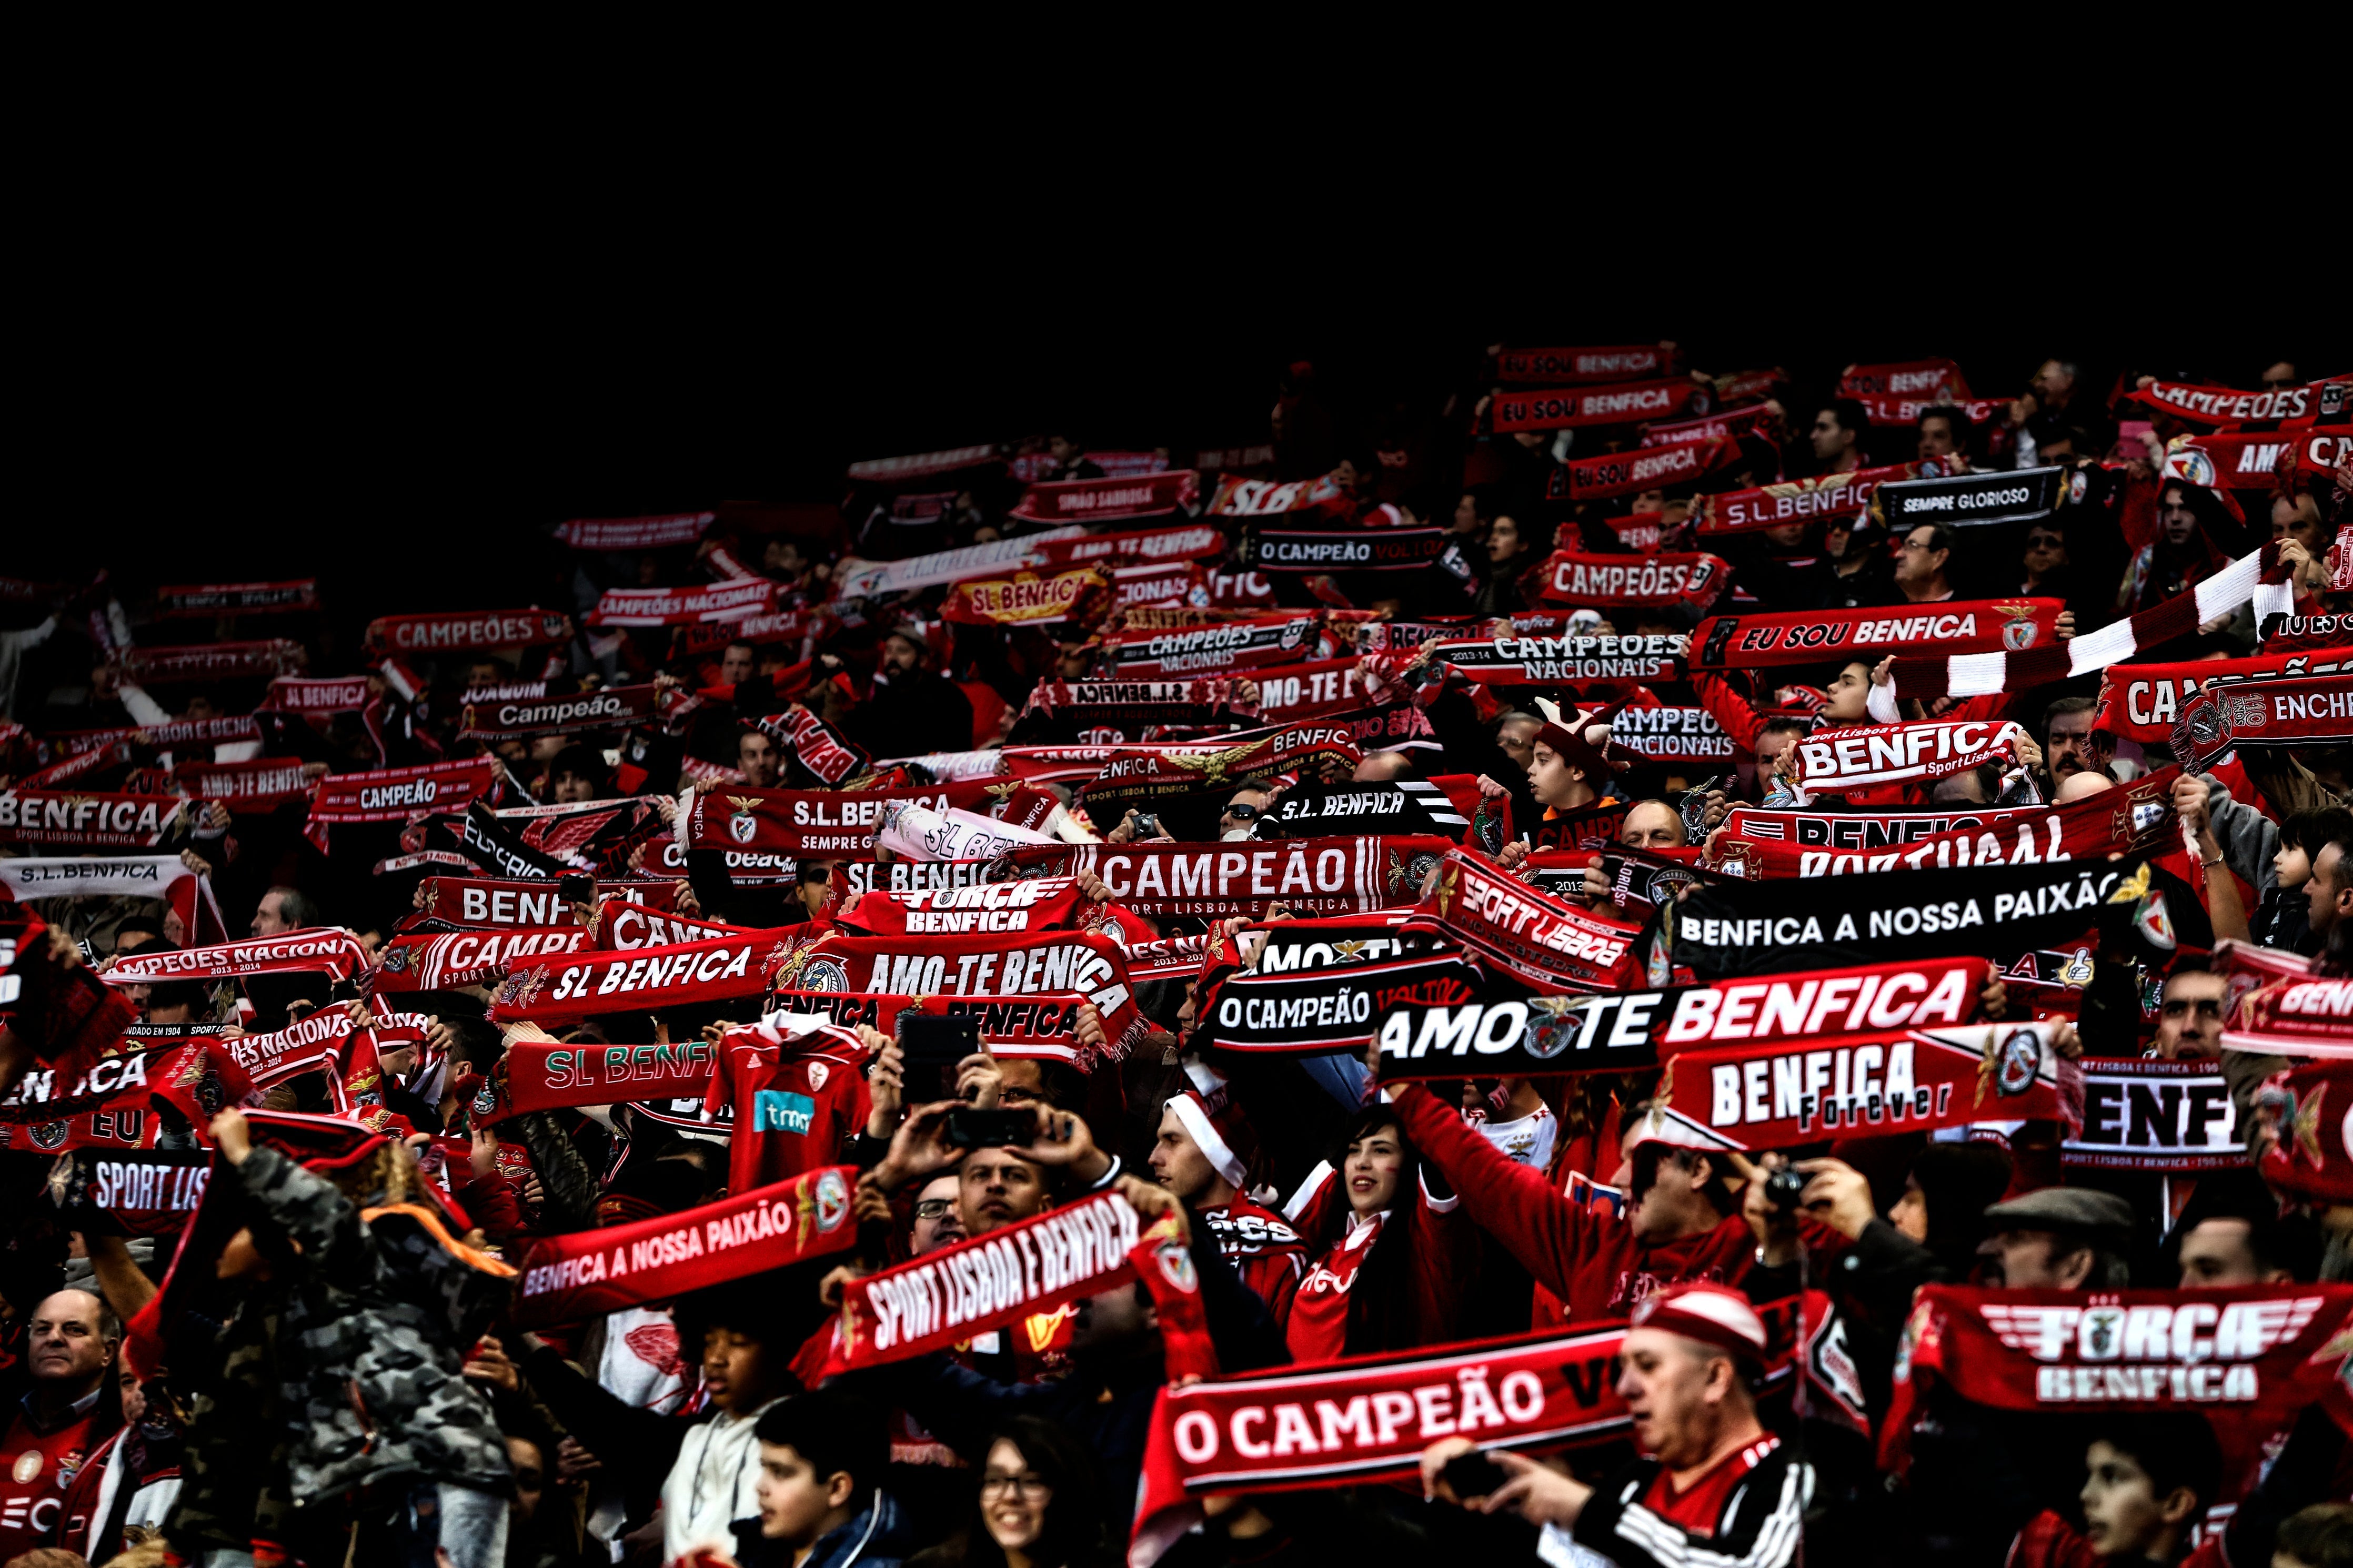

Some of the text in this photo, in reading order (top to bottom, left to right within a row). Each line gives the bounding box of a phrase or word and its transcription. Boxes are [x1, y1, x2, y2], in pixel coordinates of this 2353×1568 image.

[1533, 356, 1572, 374] SOU
[1577, 352, 1657, 374] BENFICA
[1502, 388, 1671, 421] EU SOU BENFICA
[1598, 461, 1629, 483] SOU
[1632, 449, 1697, 481] BENFICA
[1727, 481, 1873, 525] S.L.BENFIC
[1902, 486, 2030, 513] SEMPRE GLORIOSO
[1261, 543, 1275, 561] O
[1277, 541, 1370, 562] CAMPEÃO
[1553, 559, 1686, 598] CAMPEÕES
[684, 582, 770, 612] NACIONAIS
[972, 586, 996, 613] SL
[395, 615, 533, 648] CAMPEÕES
[1149, 623, 1256, 656] CAMPEÕES
[1740, 613, 1976, 651] EU SOU BENFICA
[1159, 649, 1236, 673] NACIONAIS
[1451, 650, 1491, 662] 2013-14
[1523, 656, 1662, 680] NACIONAIS
[286, 683, 367, 707] SL BENFICA
[498, 693, 621, 727] Campeão
[2229, 696, 2245, 727] ANOS
[2243, 693, 2267, 727] 110
[1805, 721, 2022, 777] BENFICA
[1842, 726, 1888, 739] Lisboa
[1099, 757, 1160, 781] ENFICA
[1279, 756, 1304, 773] LISBOA
[1927, 755, 1963, 776] Sport
[201, 770, 255, 801] AMO-TE
[360, 776, 437, 811] CAMPEÃO
[1086, 790, 1117, 804] SPORT
[1119, 786, 1145, 797] LISBOA
[1157, 784, 1190, 795] BENFICA
[0, 798, 159, 834] BENFICA
[794, 800, 839, 827] S.L.
[1282, 792, 1405, 821] S.L. BENFICA
[15, 828, 136, 845] SPORT LISBOA E BENFICA
[801, 833, 857, 851] SEMPRE
[924, 823, 962, 859] SL
[20, 862, 159, 884] S.L.BENFICA
[848, 862, 880, 894] SL
[1103, 840, 1348, 898] CAMPEÃO
[905, 909, 1029, 933] BENFICA
[1174, 900, 1238, 915] LISBOA
[1251, 901, 1259, 913] E
[1680, 913, 1825, 946] BENFICA
[1834, 913, 1858, 942] A
[1868, 896, 1985, 939] NOSSA
[1531, 905, 1627, 968] LISBOA
[210, 963, 262, 976] 2013 2014
[444, 966, 485, 985] SPORT
[552, 945, 752, 1001] SL BENFICA
[1152, 958, 1180, 967] 2013
[866, 946, 1130, 1019] AMO-TE BENFICA
[1219, 997, 1242, 1028] O
[1245, 987, 1371, 1030] CAMPEÃO
[1380, 998, 1530, 1059] AMO
[1575, 992, 1664, 1050] TE
[1664, 967, 1968, 1044] BENFICA
[153, 1027, 181, 1036] EM 1904
[190, 1026, 212, 1035] SPORT
[545, 1050, 595, 1089] SL
[1710, 1041, 1918, 1128] BENFICA
[1797, 1081, 1954, 1134] Forever
[91, 1109, 144, 1144] EU
[95, 1160, 169, 1211] SPORT
[523, 1199, 792, 1297] BENFICA A NOSSA PAIXÃO
[866, 1191, 1140, 1351] SPORT LISBOA E BENFICA
[1999, 1297, 2302, 1368] FORÇA
[2036, 1363, 2259, 1403] BENFICA
[1173, 1364, 1546, 1464] O CAMPEÃO
